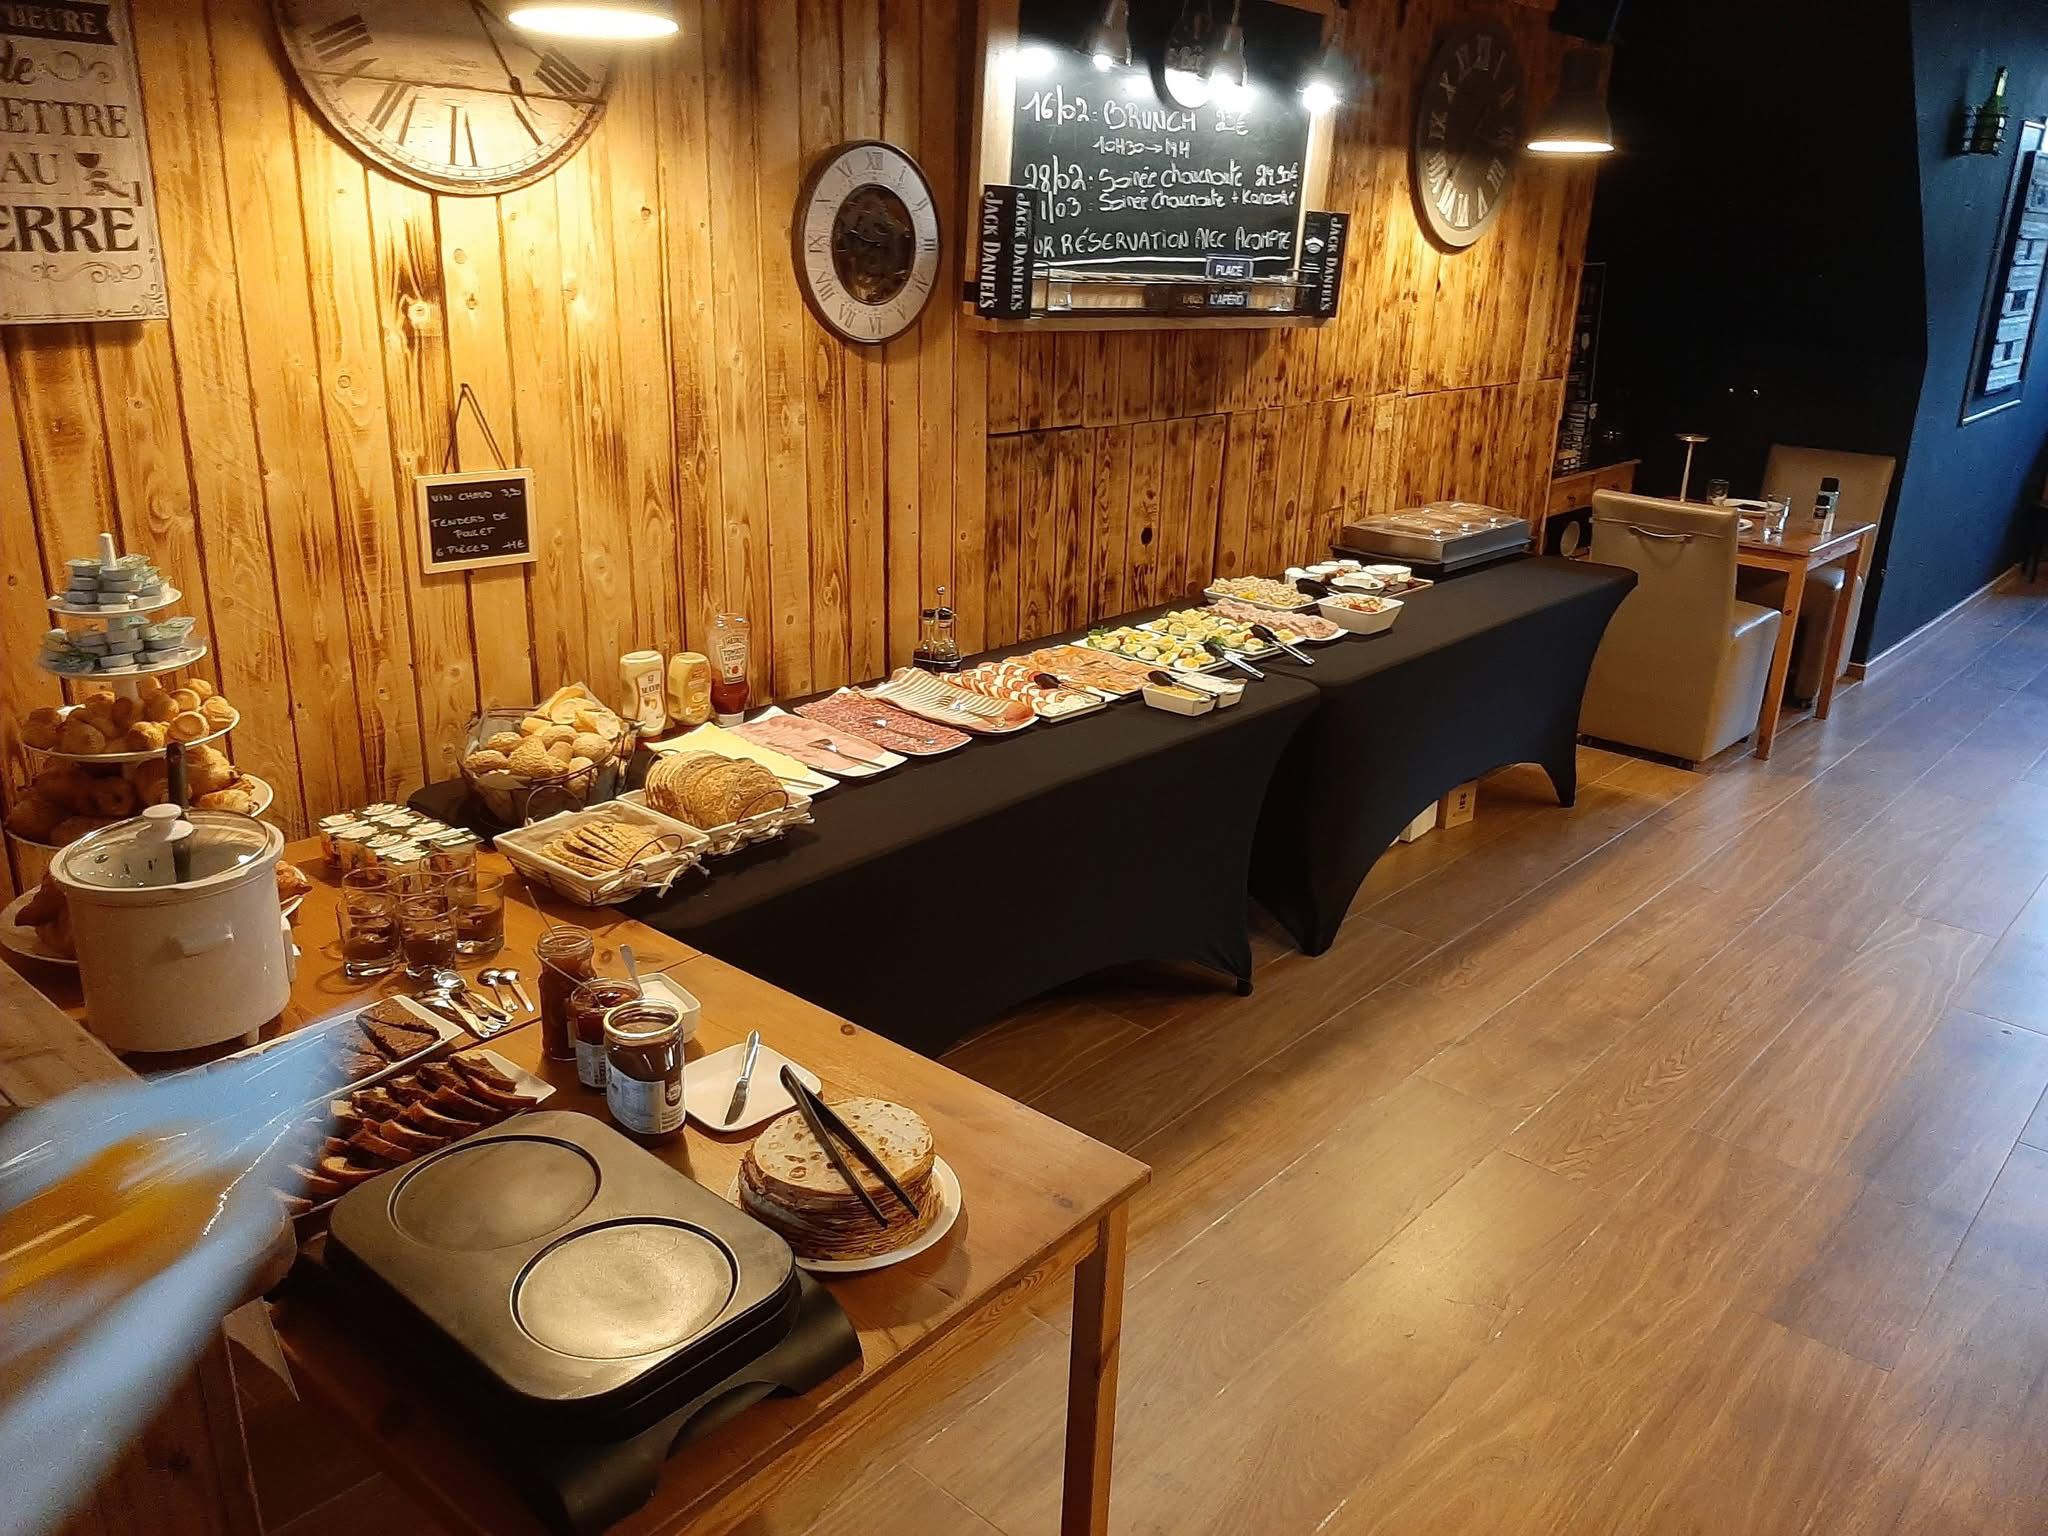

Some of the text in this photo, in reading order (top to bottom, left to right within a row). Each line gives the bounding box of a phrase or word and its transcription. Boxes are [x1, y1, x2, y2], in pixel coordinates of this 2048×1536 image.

[0, 98, 129, 138] ETTRE
[1103, 99, 1197, 132] BRUNCH
[0, 153, 58, 185] AU
[979, 190, 1004, 309] JACK DANIEL'S
[1010, 192, 1031, 311] JACK DANIEL'S
[1034, 235, 1055, 258] UR
[1060, 228, 1189, 255] RÉSERVATION
[1320, 216, 1343, 312] JACK DANIEL'S
[492, 512, 510, 521] DE
